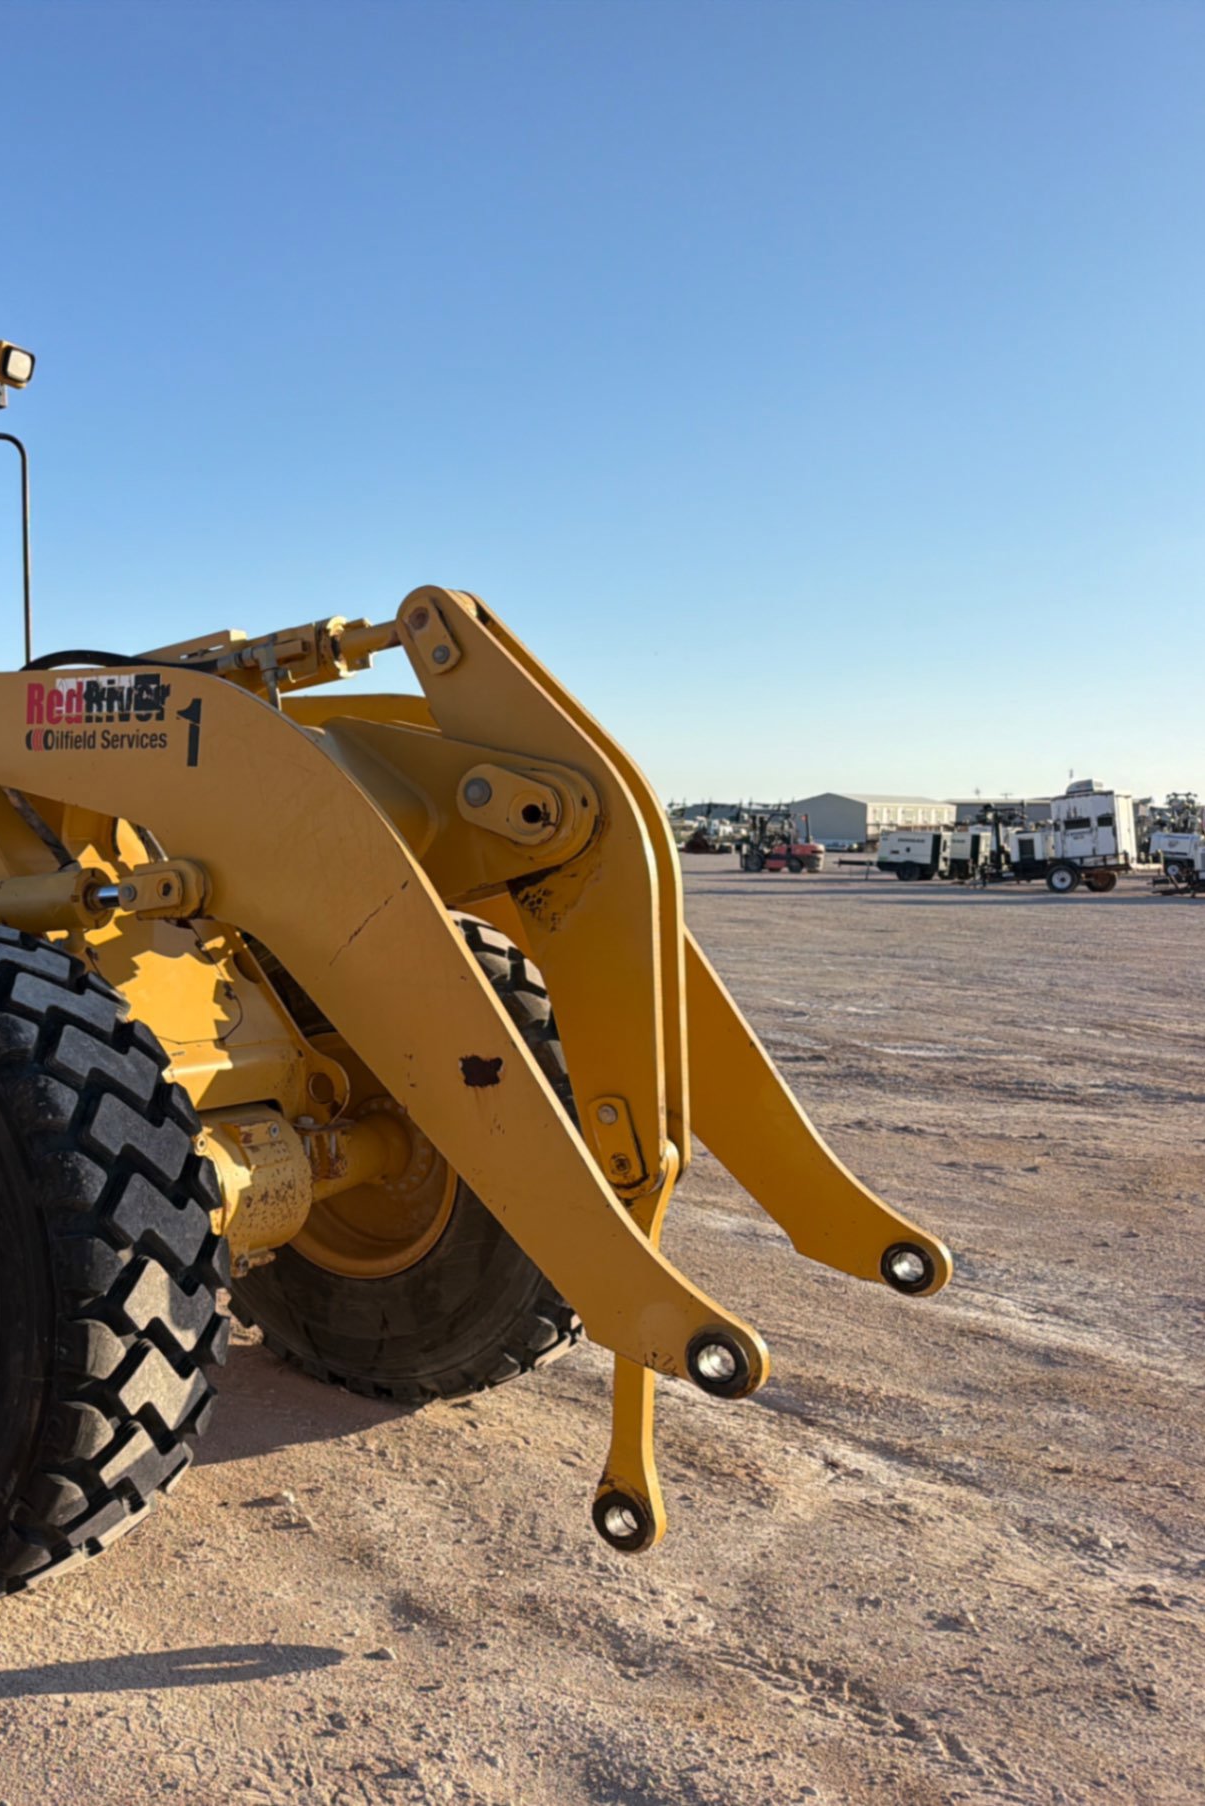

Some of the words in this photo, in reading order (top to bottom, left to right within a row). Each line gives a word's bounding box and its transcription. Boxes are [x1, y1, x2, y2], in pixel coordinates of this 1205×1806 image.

[43, 730, 96, 750] Oilfield
[101, 729, 168, 749] Services
[176, 698, 202, 767] 1
